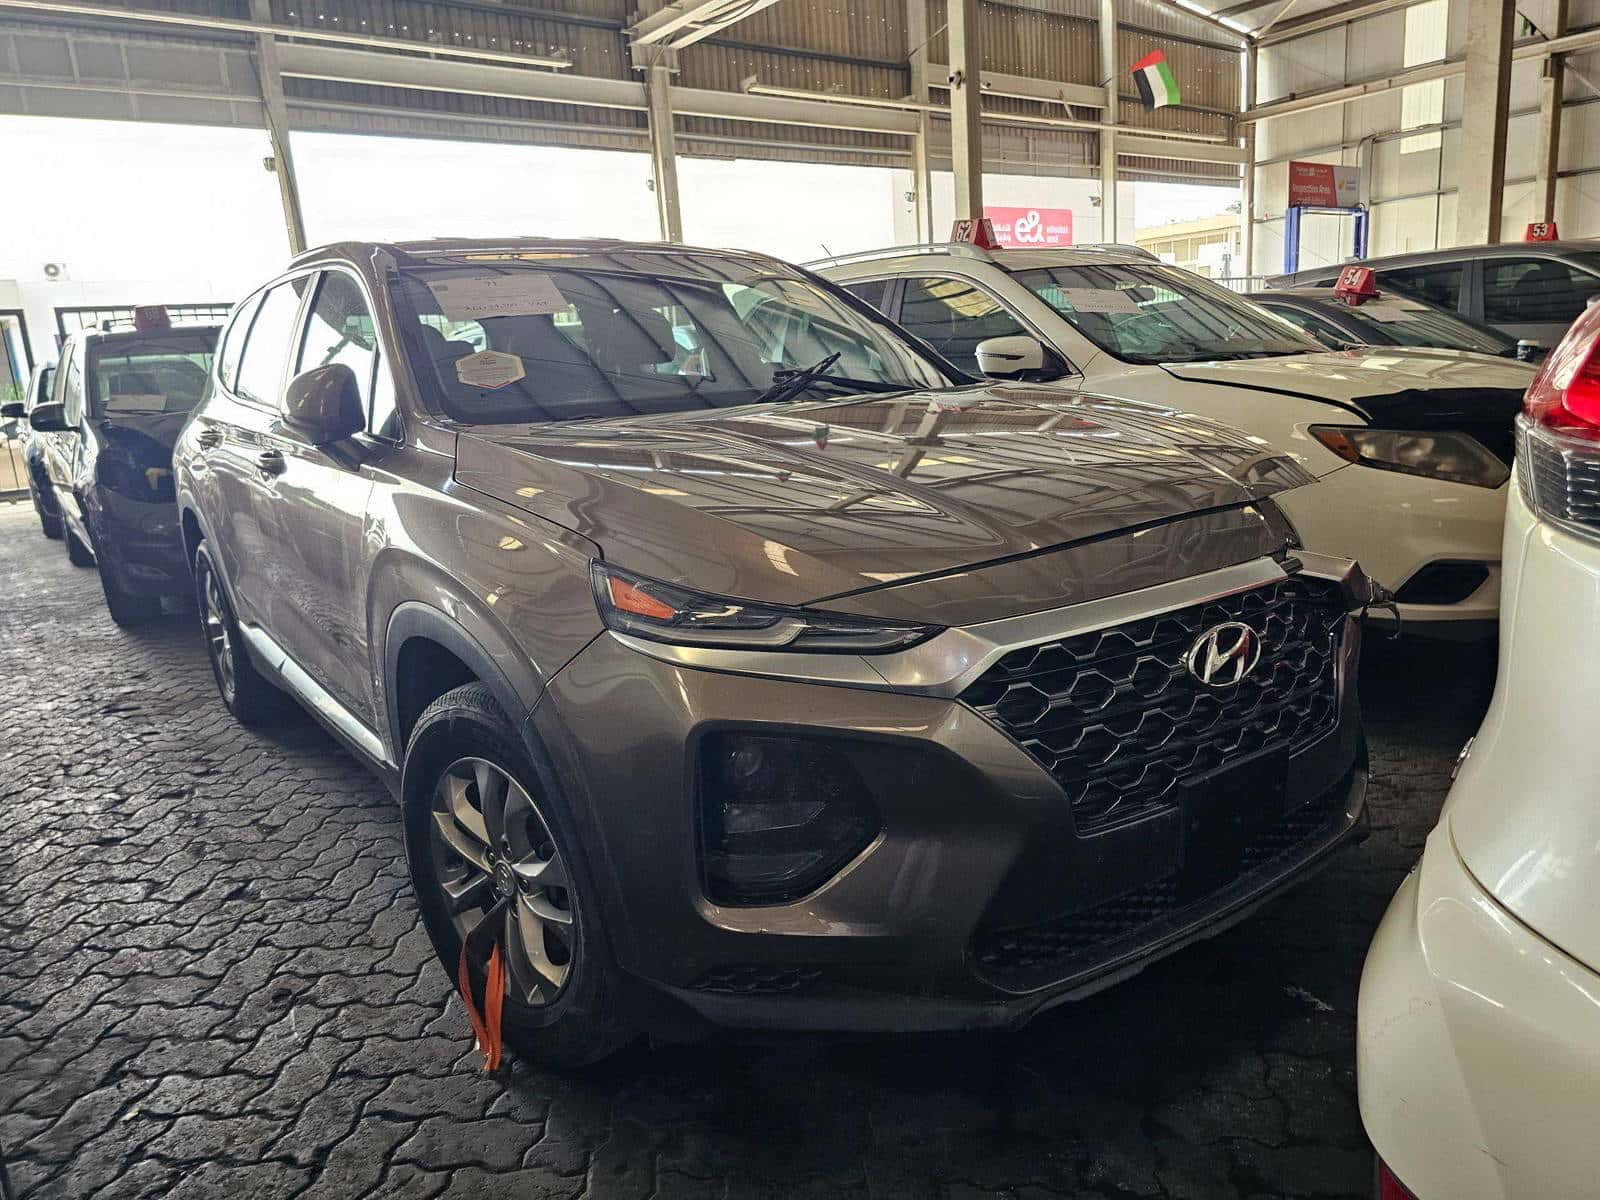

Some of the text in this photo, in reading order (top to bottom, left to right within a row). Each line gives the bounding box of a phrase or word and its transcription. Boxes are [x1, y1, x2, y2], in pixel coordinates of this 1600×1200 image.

[956, 221, 971, 241] 62
[1533, 223, 1548, 236] 53
[1344, 268, 1360, 285] 54
